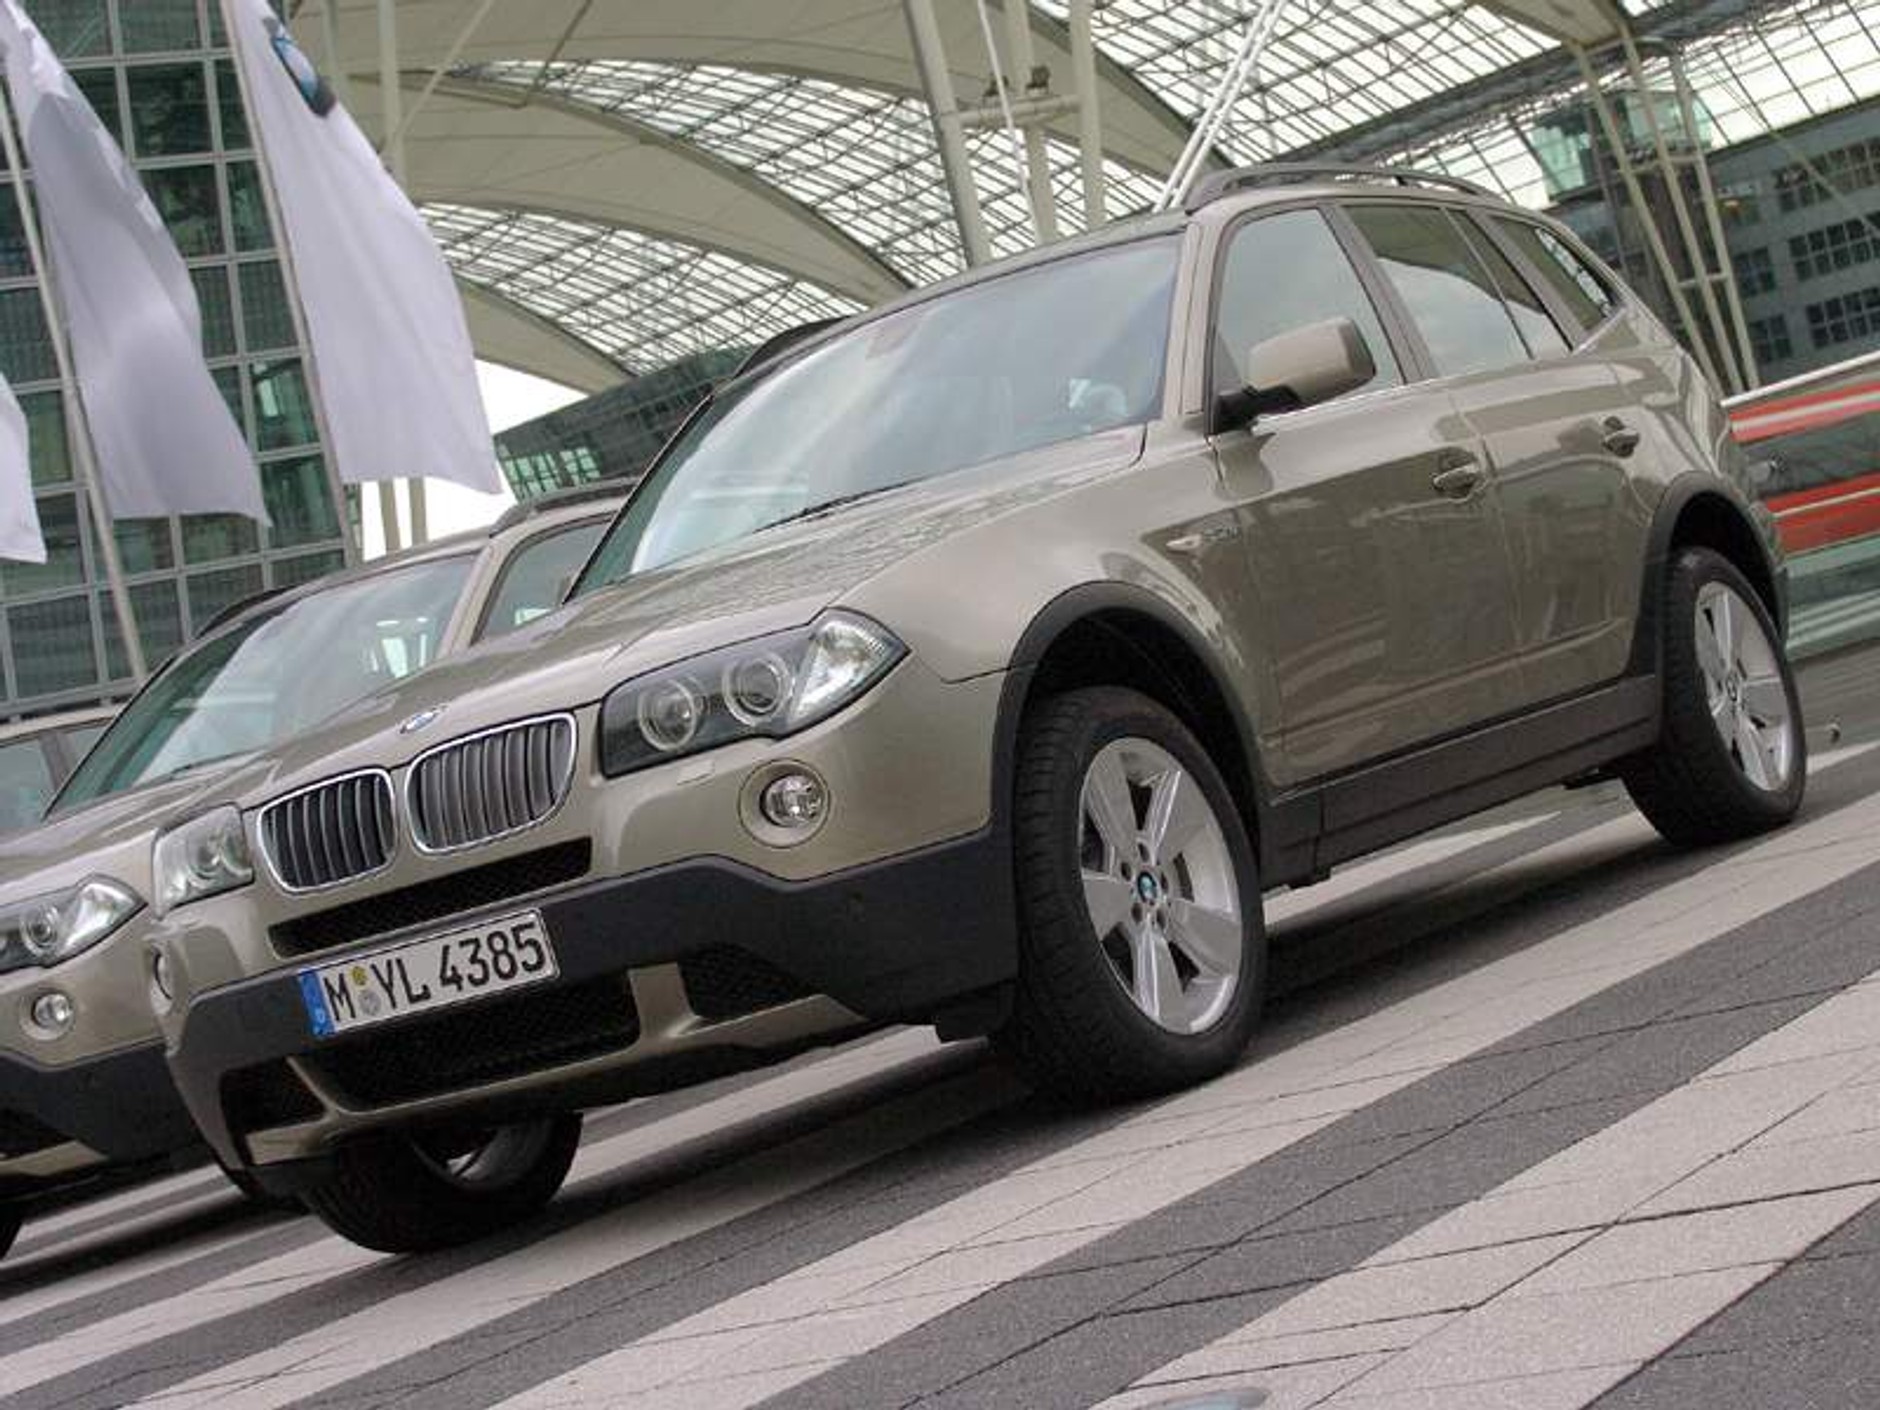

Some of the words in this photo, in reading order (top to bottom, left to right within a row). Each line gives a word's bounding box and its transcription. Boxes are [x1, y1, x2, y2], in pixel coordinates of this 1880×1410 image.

[324, 973, 356, 1021] M
[371, 958, 431, 1008] YL
[439, 924, 546, 992] 4385
